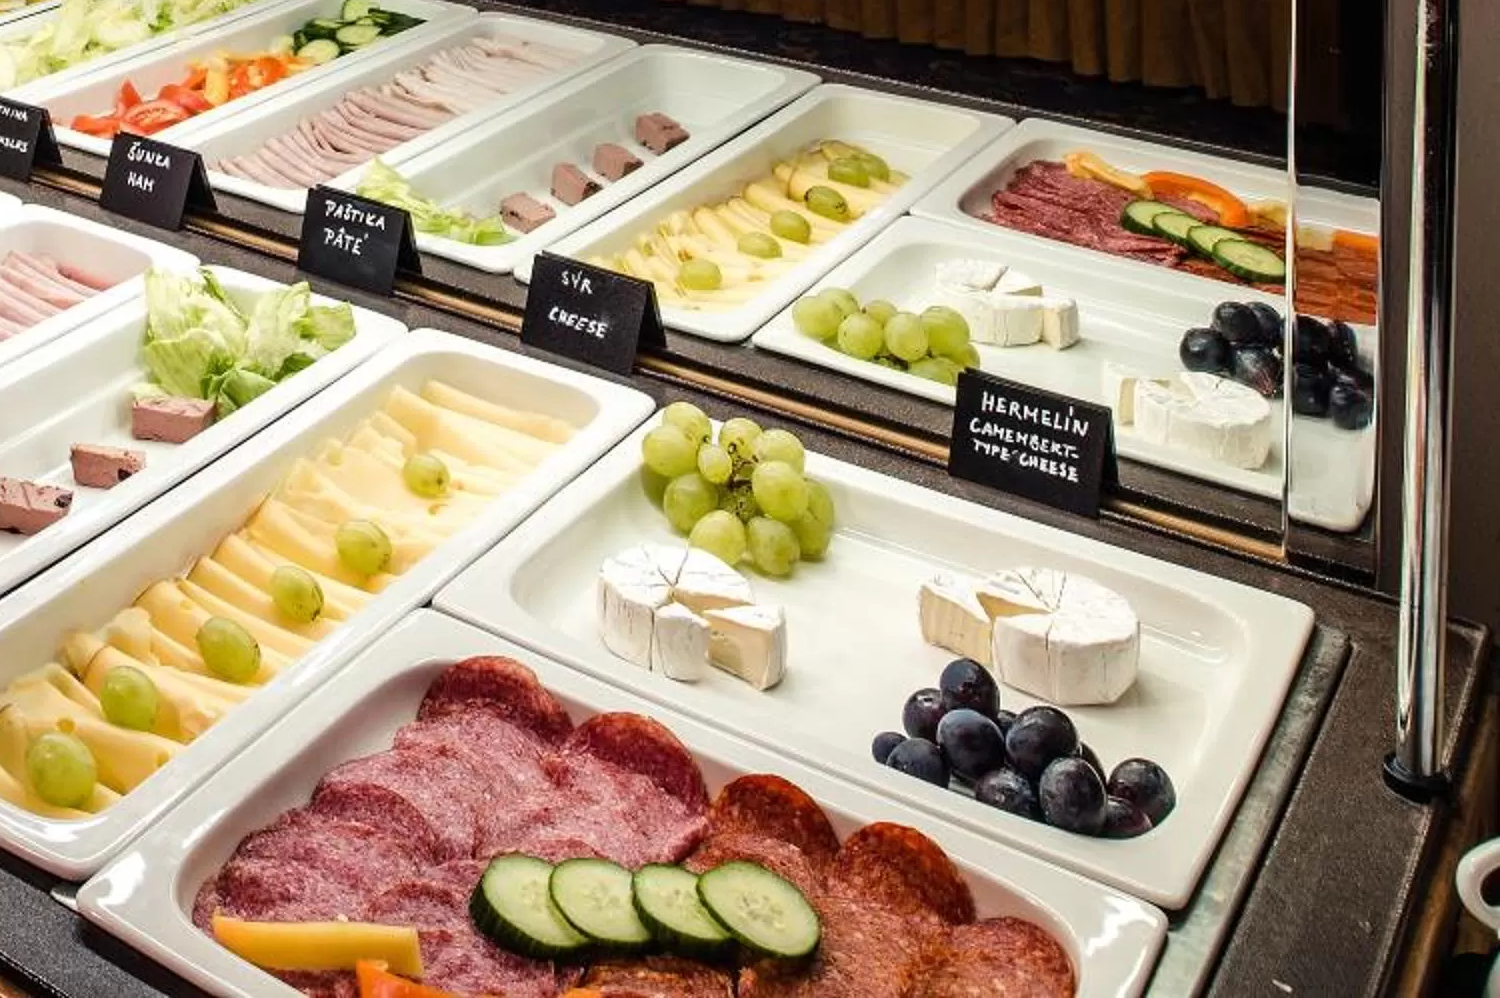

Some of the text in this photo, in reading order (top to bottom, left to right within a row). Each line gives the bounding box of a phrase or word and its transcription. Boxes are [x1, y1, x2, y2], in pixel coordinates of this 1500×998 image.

[127, 171, 155, 193] HAM
[325, 199, 386, 231] PAŠTIKA
[548, 306, 608, 338] CHEESE
[981, 391, 1089, 437] HERMELÍN
